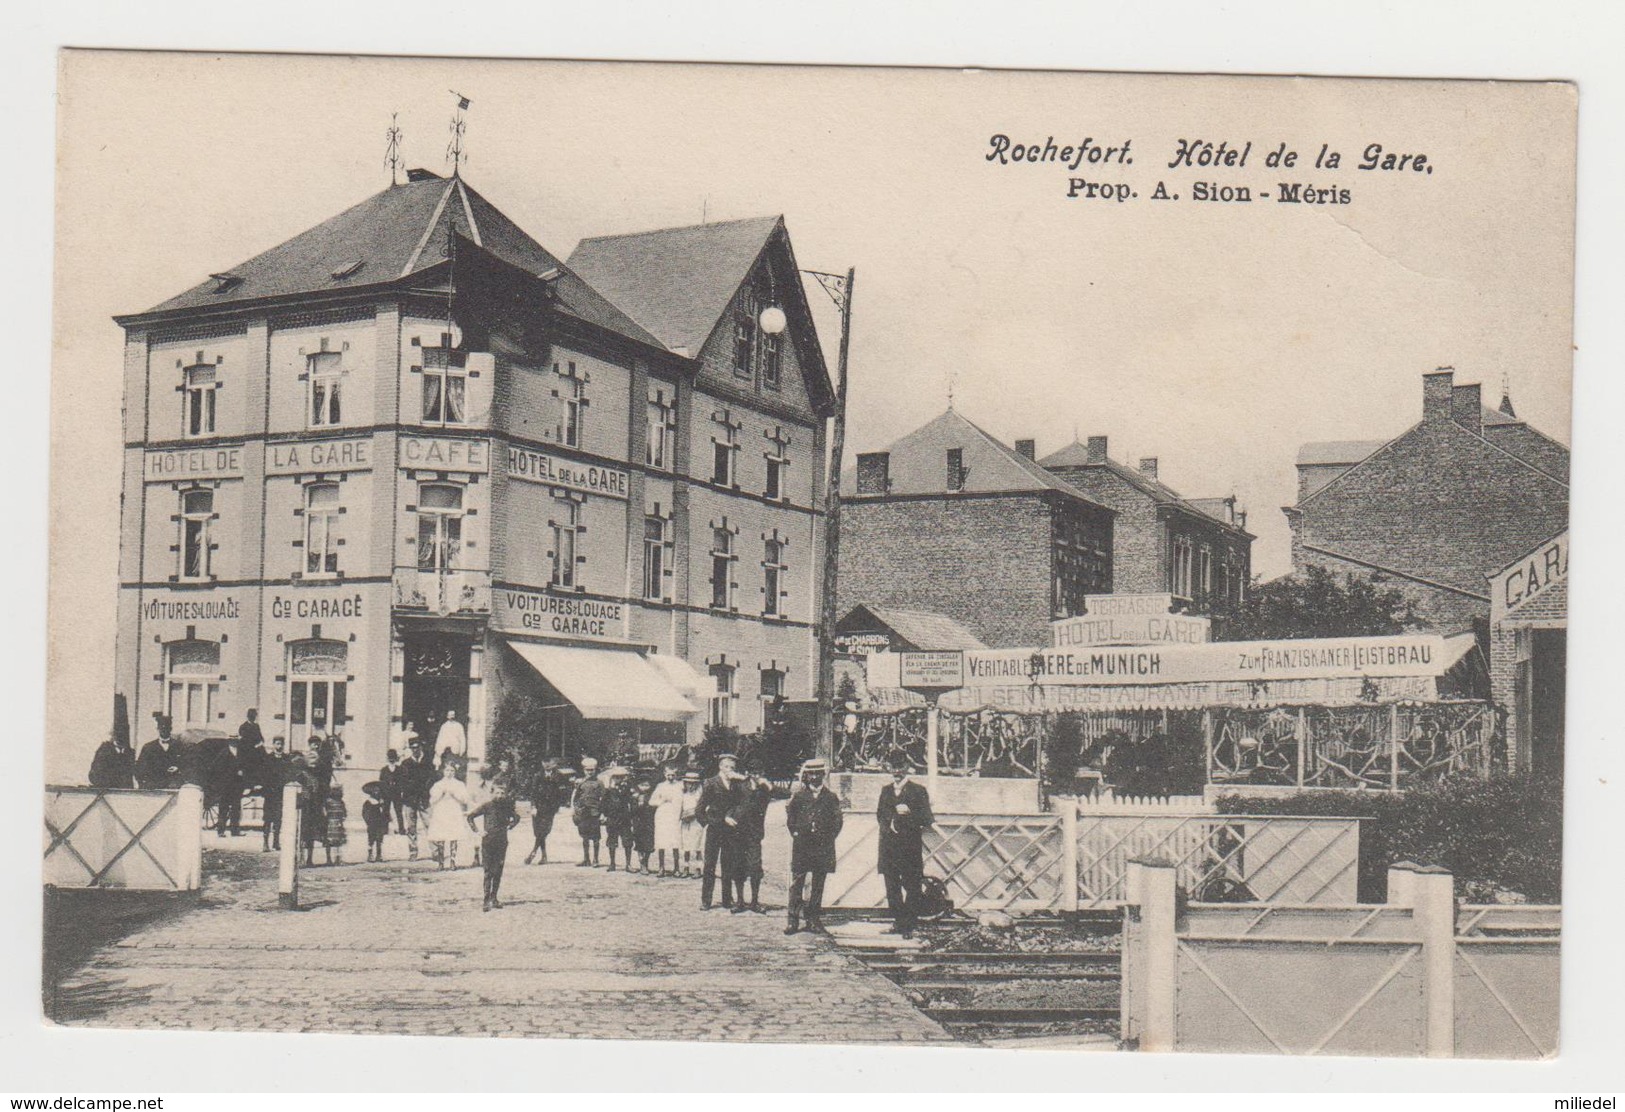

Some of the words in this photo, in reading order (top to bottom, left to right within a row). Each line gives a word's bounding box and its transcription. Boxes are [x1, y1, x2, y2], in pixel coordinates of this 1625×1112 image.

[216, 450, 239, 471] DE
[274, 447, 299, 468] LA
[310, 441, 366, 465] GARE
[558, 467, 572, 481] DE
[572, 471, 586, 484] LA
[587, 467, 628, 493] GARE
[143, 600, 198, 620] VOITURES
[201, 599, 240, 619] LOUAGE
[297, 596, 363, 618] GARAGE
[507, 593, 572, 615] VOITURES
[551, 616, 606, 637] GARAGE
[1147, 618, 1201, 644] GARE
[1077, 662, 1090, 675] DE
[1091, 652, 1161, 674] MUNICH
